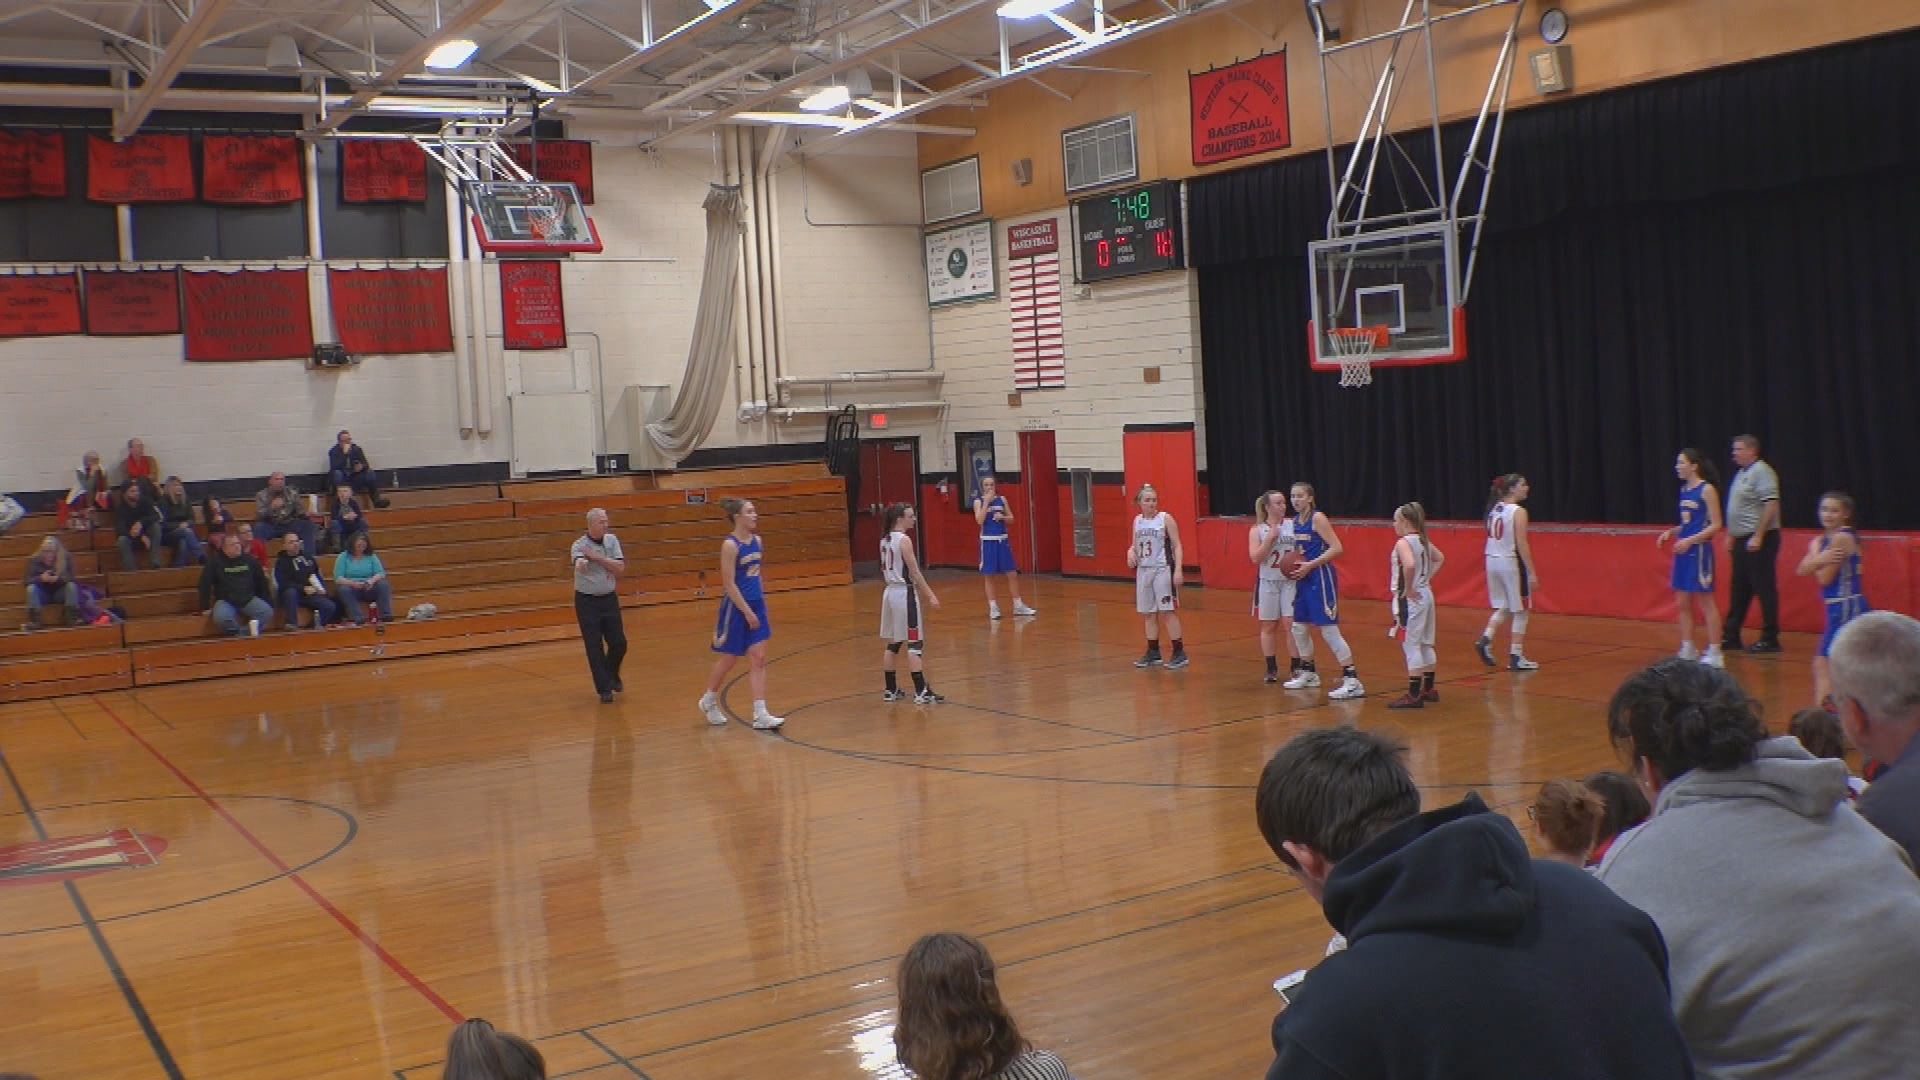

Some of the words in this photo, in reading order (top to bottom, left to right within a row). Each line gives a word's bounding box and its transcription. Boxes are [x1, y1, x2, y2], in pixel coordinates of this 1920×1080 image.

[1227, 70, 1252, 82] MAINE
[1253, 71, 1275, 97] CLASS
[1208, 116, 1273, 140] BASEBALL
[1202, 134, 1256, 157] CHAMPIONS
[1259, 127, 1281, 145] 2014
[1111, 191, 1149, 221] 7:48
[1012, 223, 1052, 239] WISCASSET
[1145, 217, 1165, 231] GUEST
[1011, 234, 1055, 251] BASKETBALL
[1083, 229, 1103, 242] HOME
[1098, 241, 1109, 267] 0
[1139, 540, 1152, 559] 13
